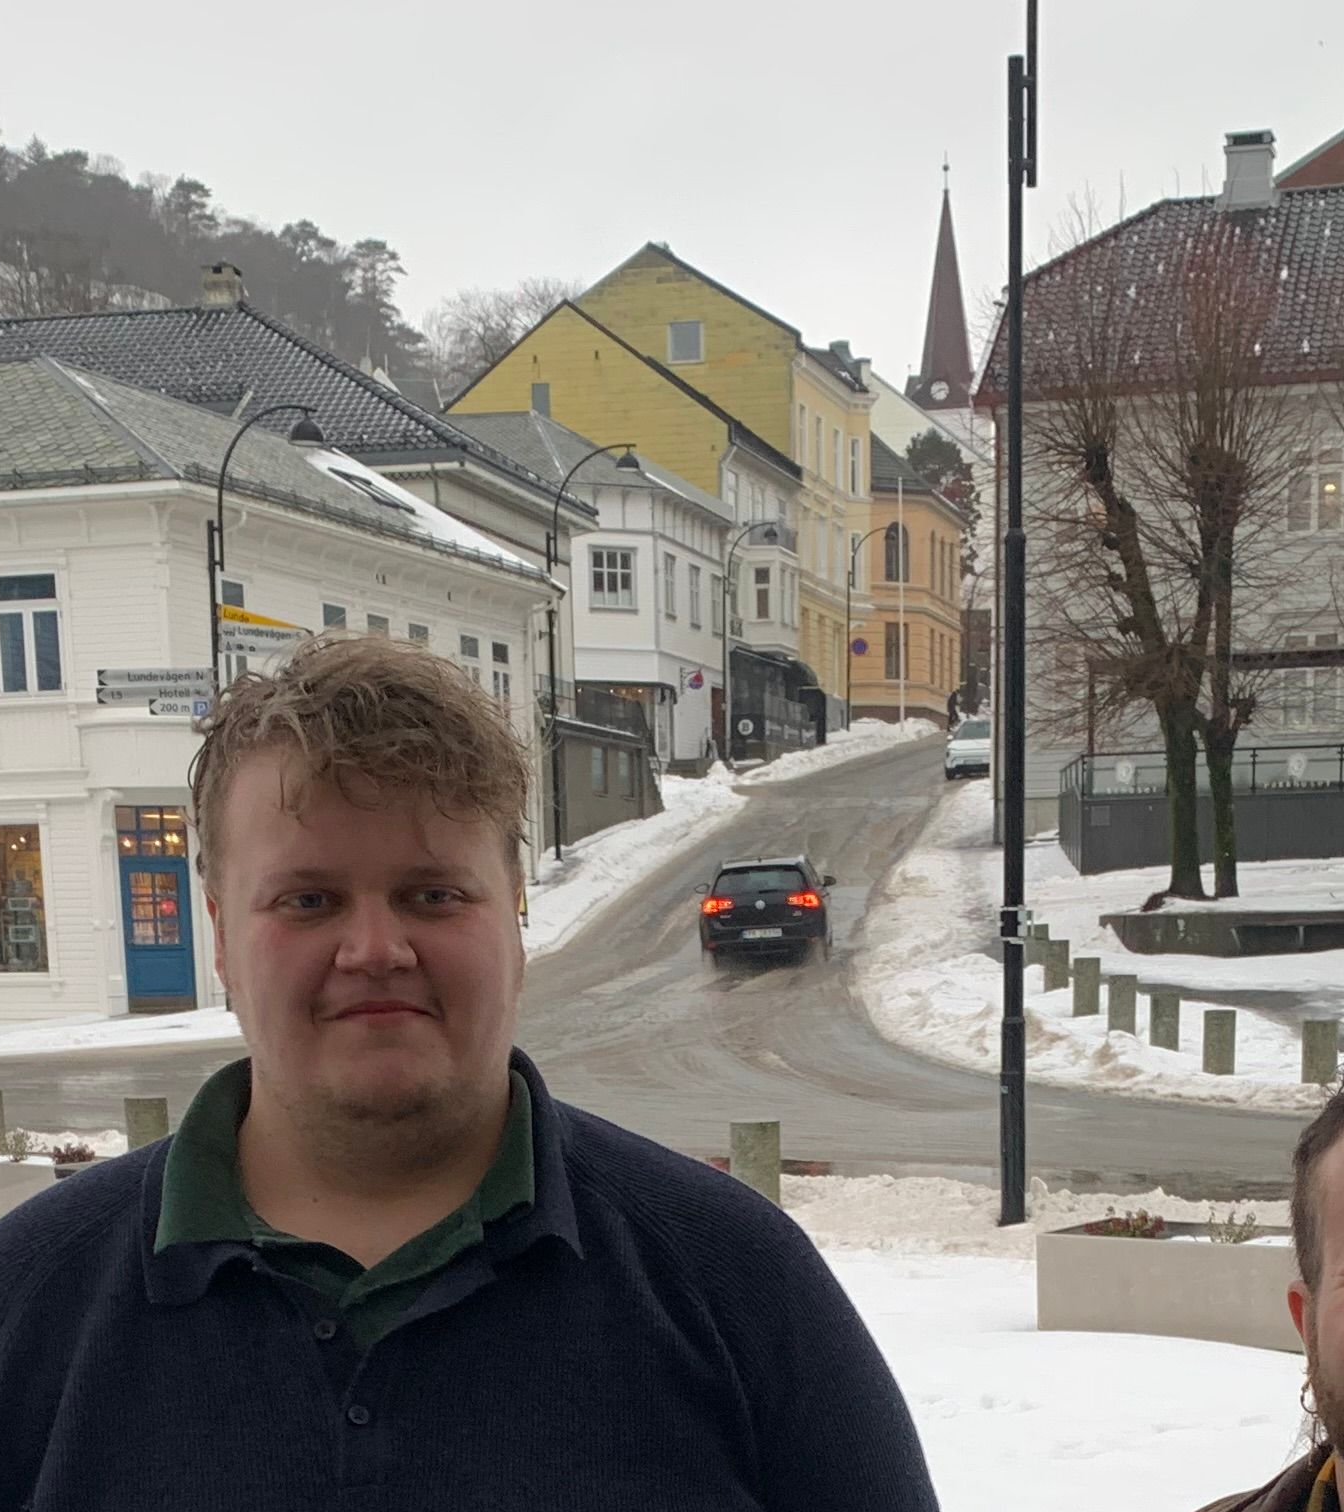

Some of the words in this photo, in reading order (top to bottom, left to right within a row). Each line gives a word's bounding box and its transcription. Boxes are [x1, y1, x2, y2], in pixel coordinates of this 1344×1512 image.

[223, 608, 250, 624] Lunde
[196, 671, 204, 680] N
[159, 687, 191, 698] Hotell
[159, 703, 179, 713] 200
[181, 704, 191, 713] m
